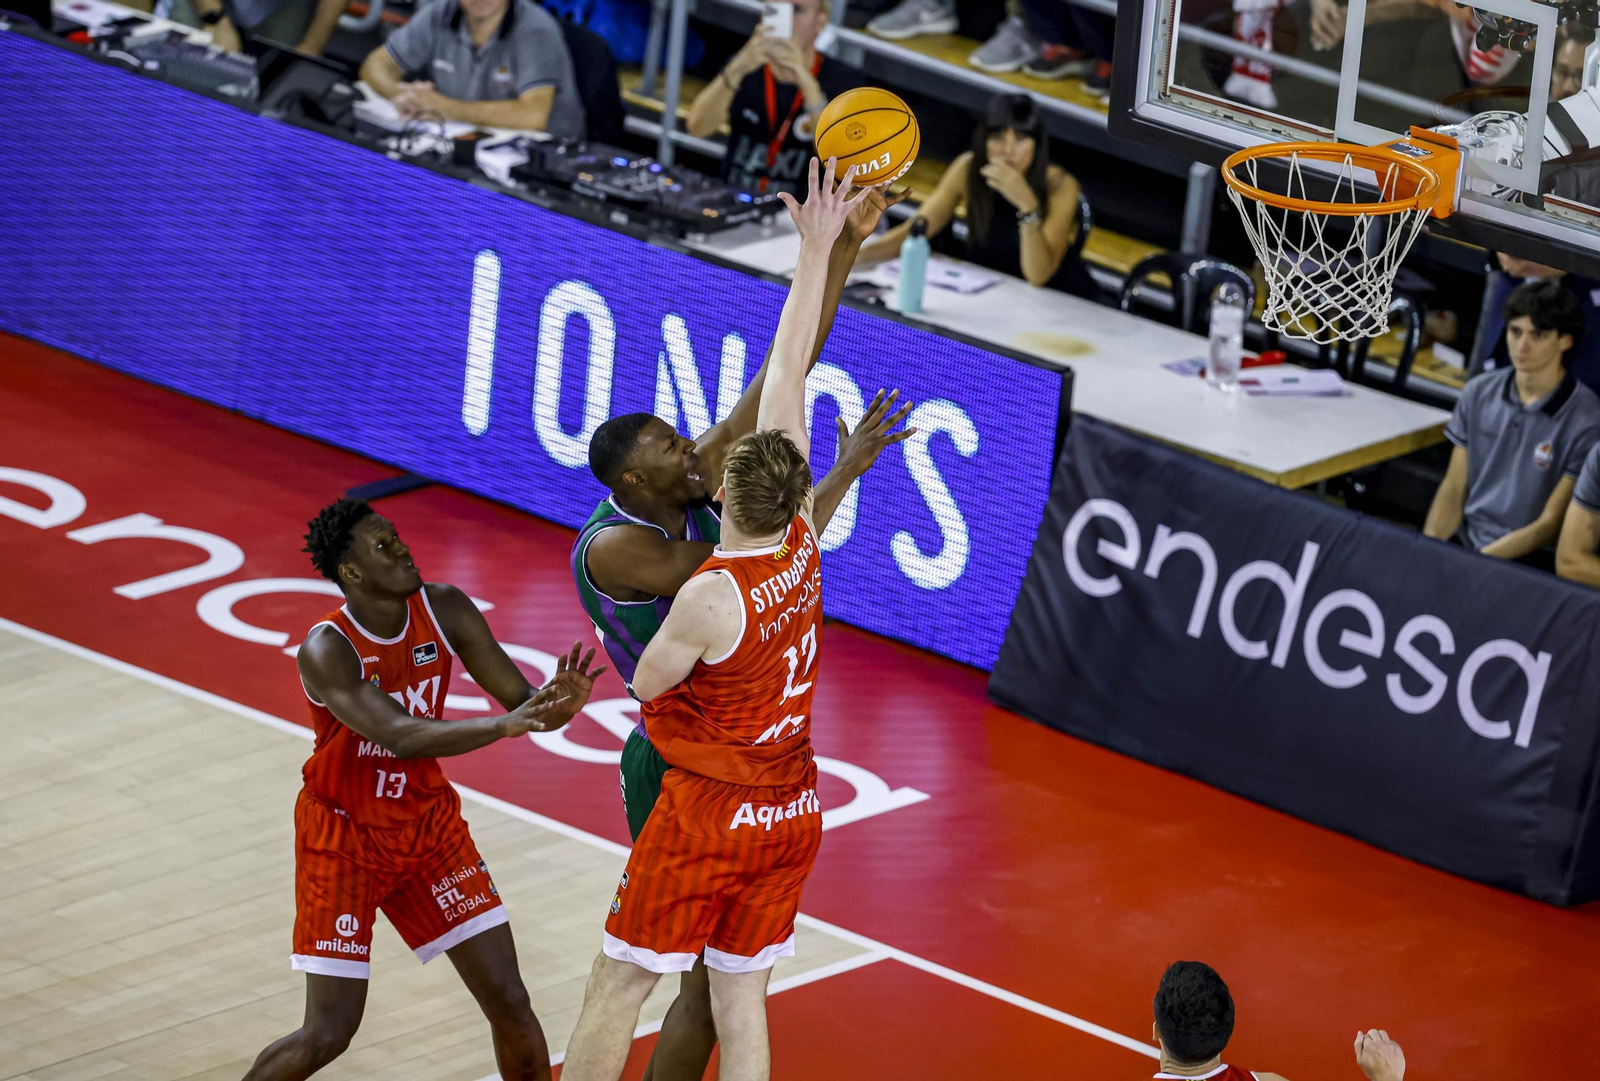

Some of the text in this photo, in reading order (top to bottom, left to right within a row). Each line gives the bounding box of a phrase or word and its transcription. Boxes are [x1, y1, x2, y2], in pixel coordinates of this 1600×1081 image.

[1062, 498, 1553, 748] endesa
[375, 768, 407, 799] 13
[435, 887, 465, 910] ETL
[444, 892, 491, 922] GLOBAL
[316, 938, 368, 955] unilabor
